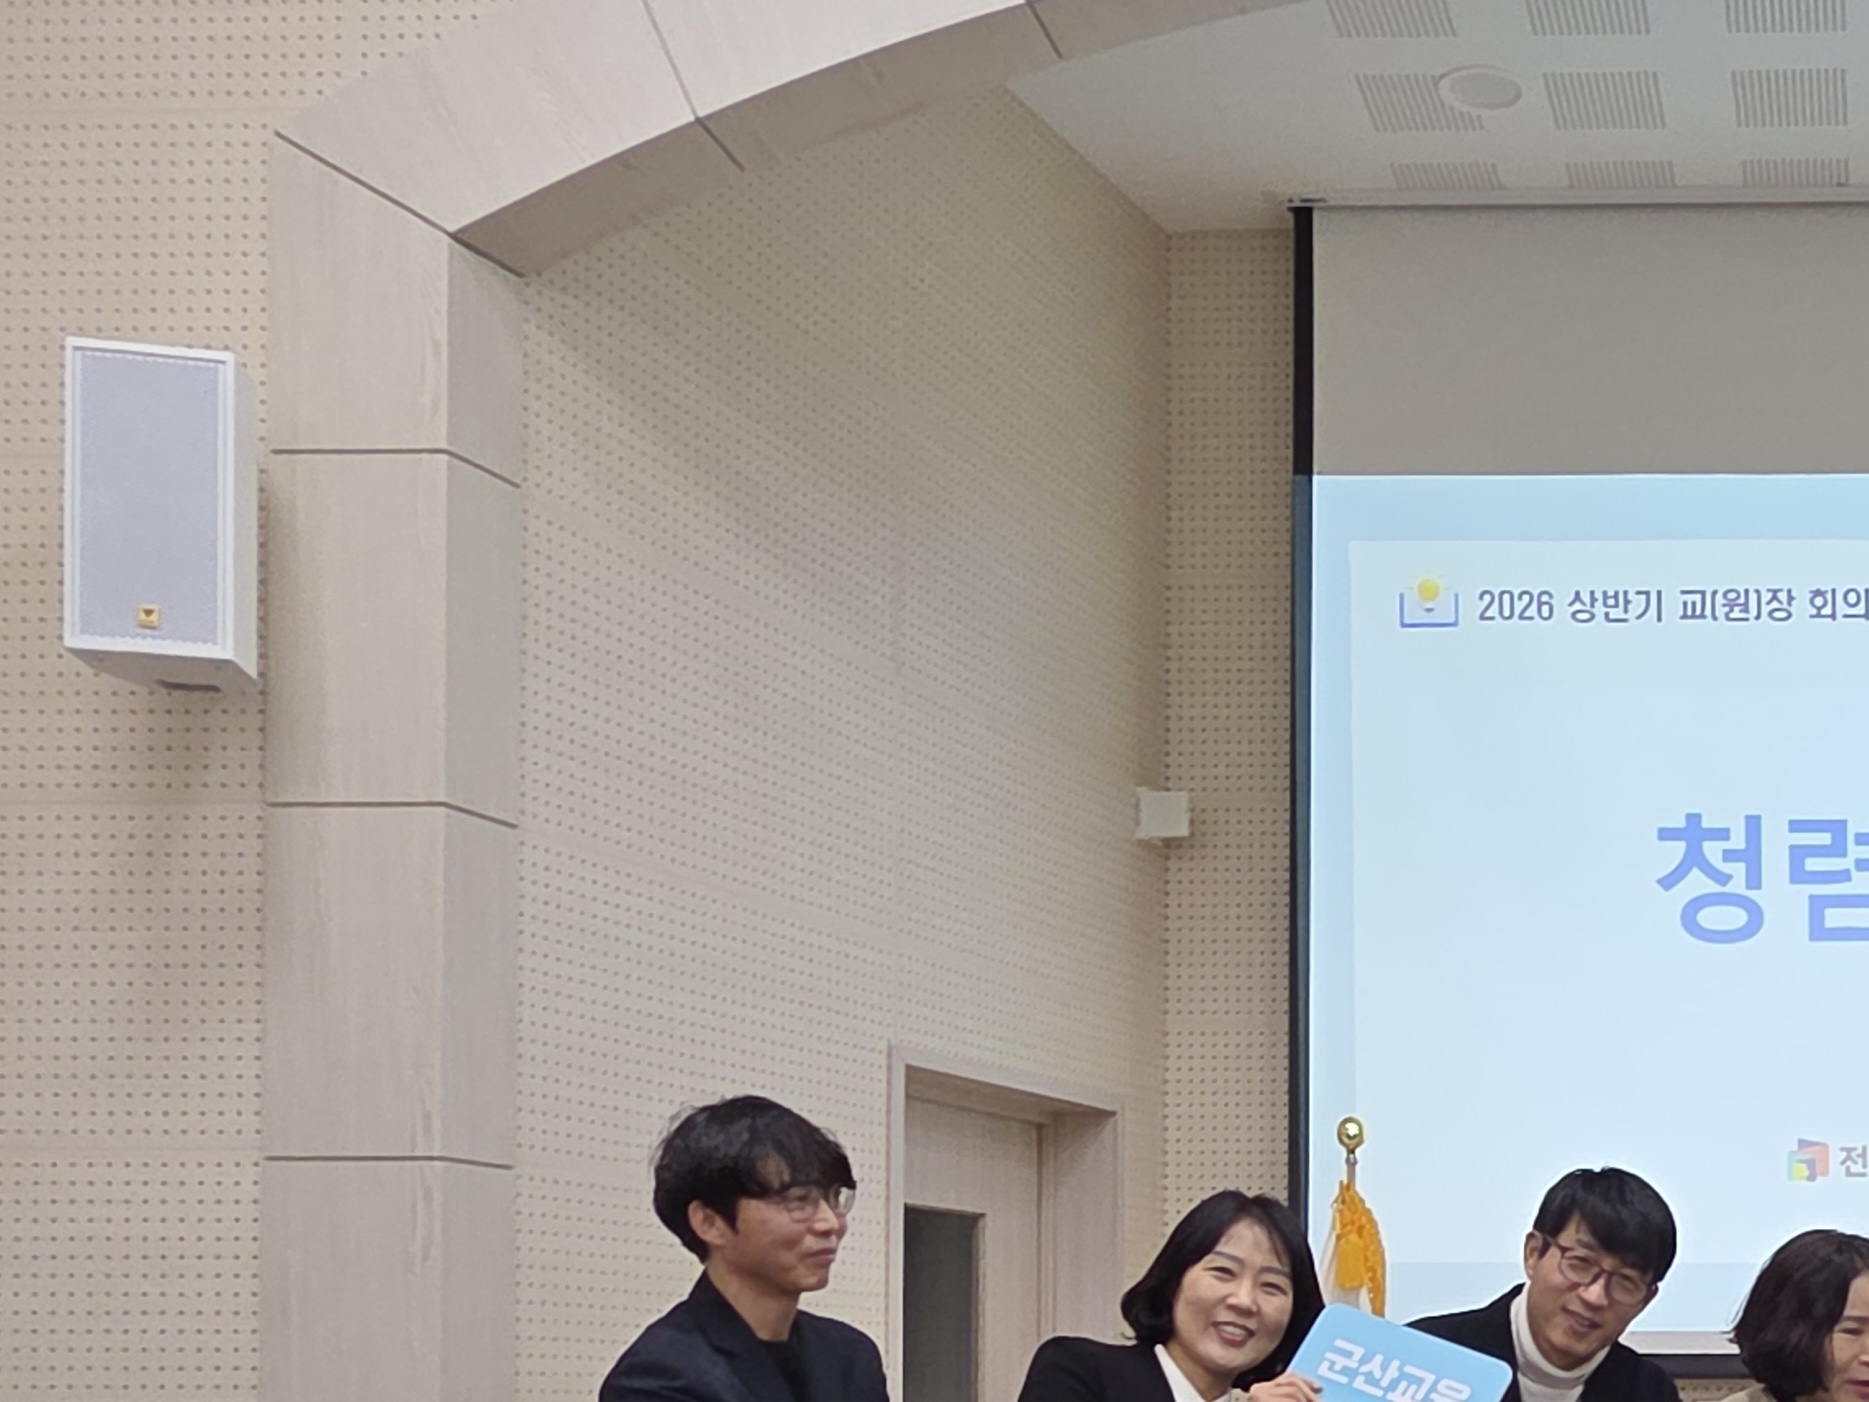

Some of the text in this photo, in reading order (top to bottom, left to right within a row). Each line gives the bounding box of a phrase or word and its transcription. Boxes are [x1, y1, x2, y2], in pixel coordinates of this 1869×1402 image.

[1477, 589, 1554, 622] 2026
[1567, 588, 1664, 624] 상반기
[1679, 587, 1796, 624] 교(원)장
